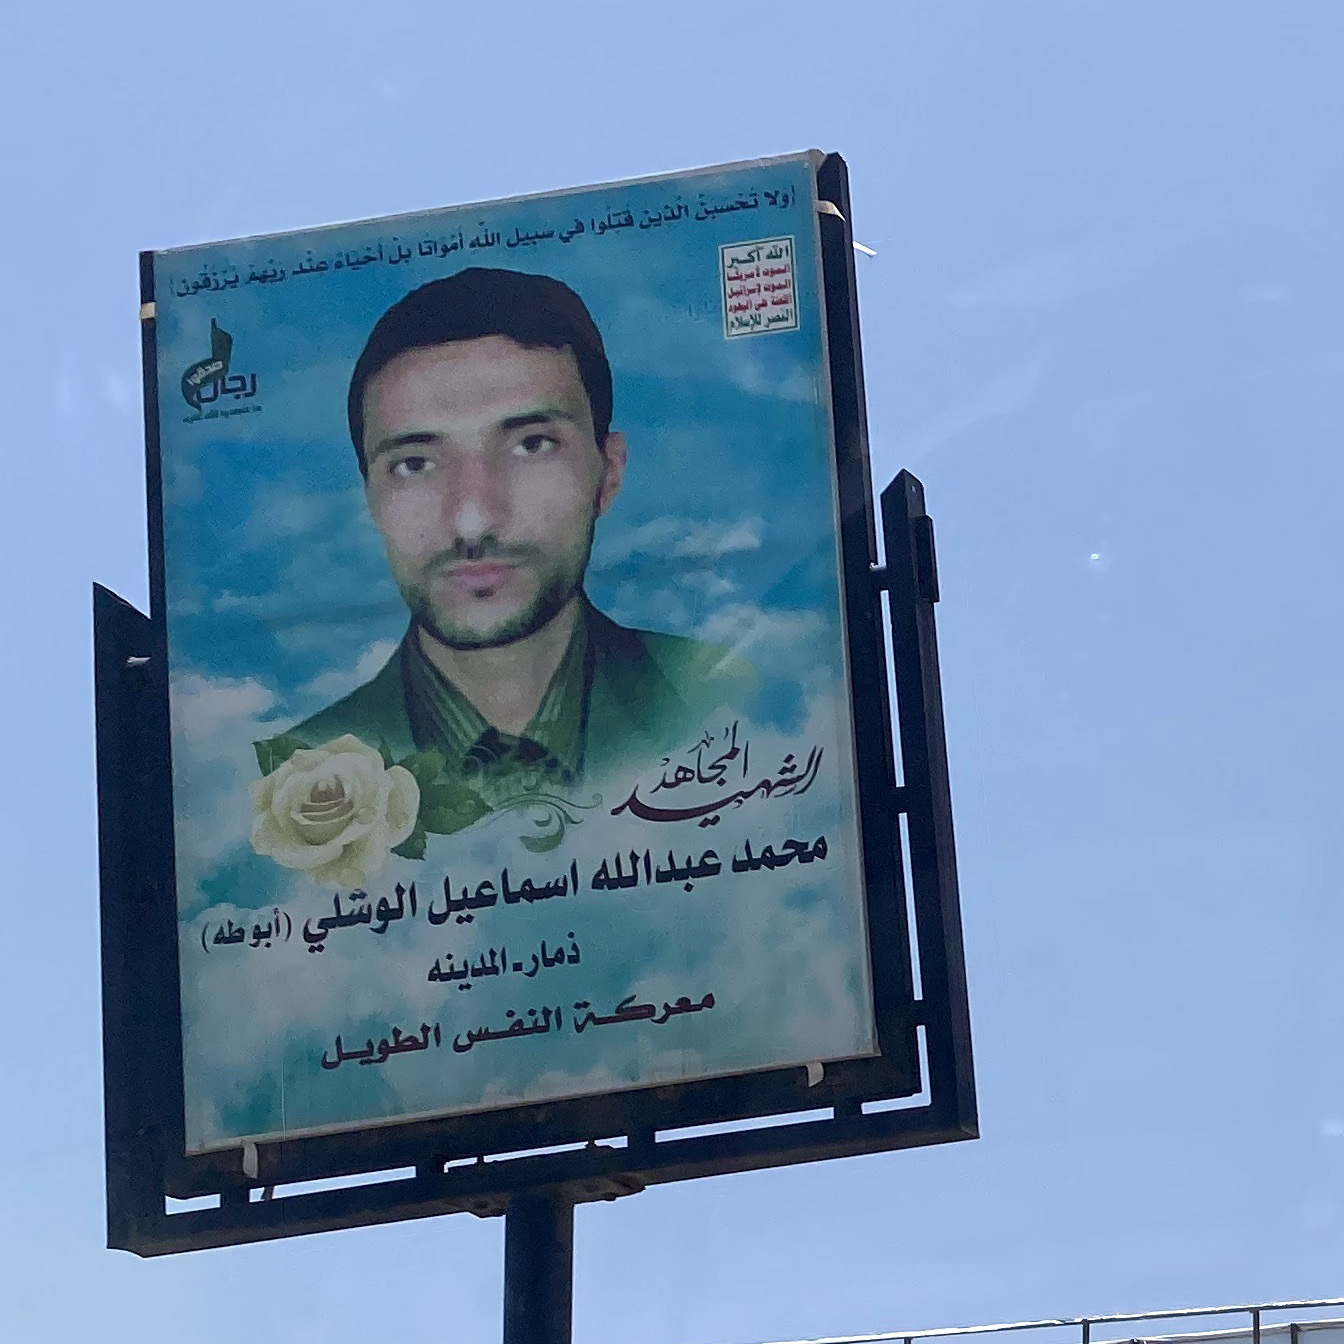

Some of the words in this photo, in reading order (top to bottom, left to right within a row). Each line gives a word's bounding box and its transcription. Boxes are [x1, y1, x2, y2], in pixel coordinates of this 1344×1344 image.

[725, 245, 765, 269] أكبر
[765, 244, 790, 260] الله
[648, 719, 750, 794] المجاهد
[610, 744, 825, 830] الشهيد
[731, 835, 829, 874] محمد
[200, 918, 245, 954] طه)
[302, 880, 418, 954] الوشلي
[452, 1004, 563, 1054] النفس
[572, 992, 717, 1035] معركة
[320, 1021, 442, 1071] الطويل
